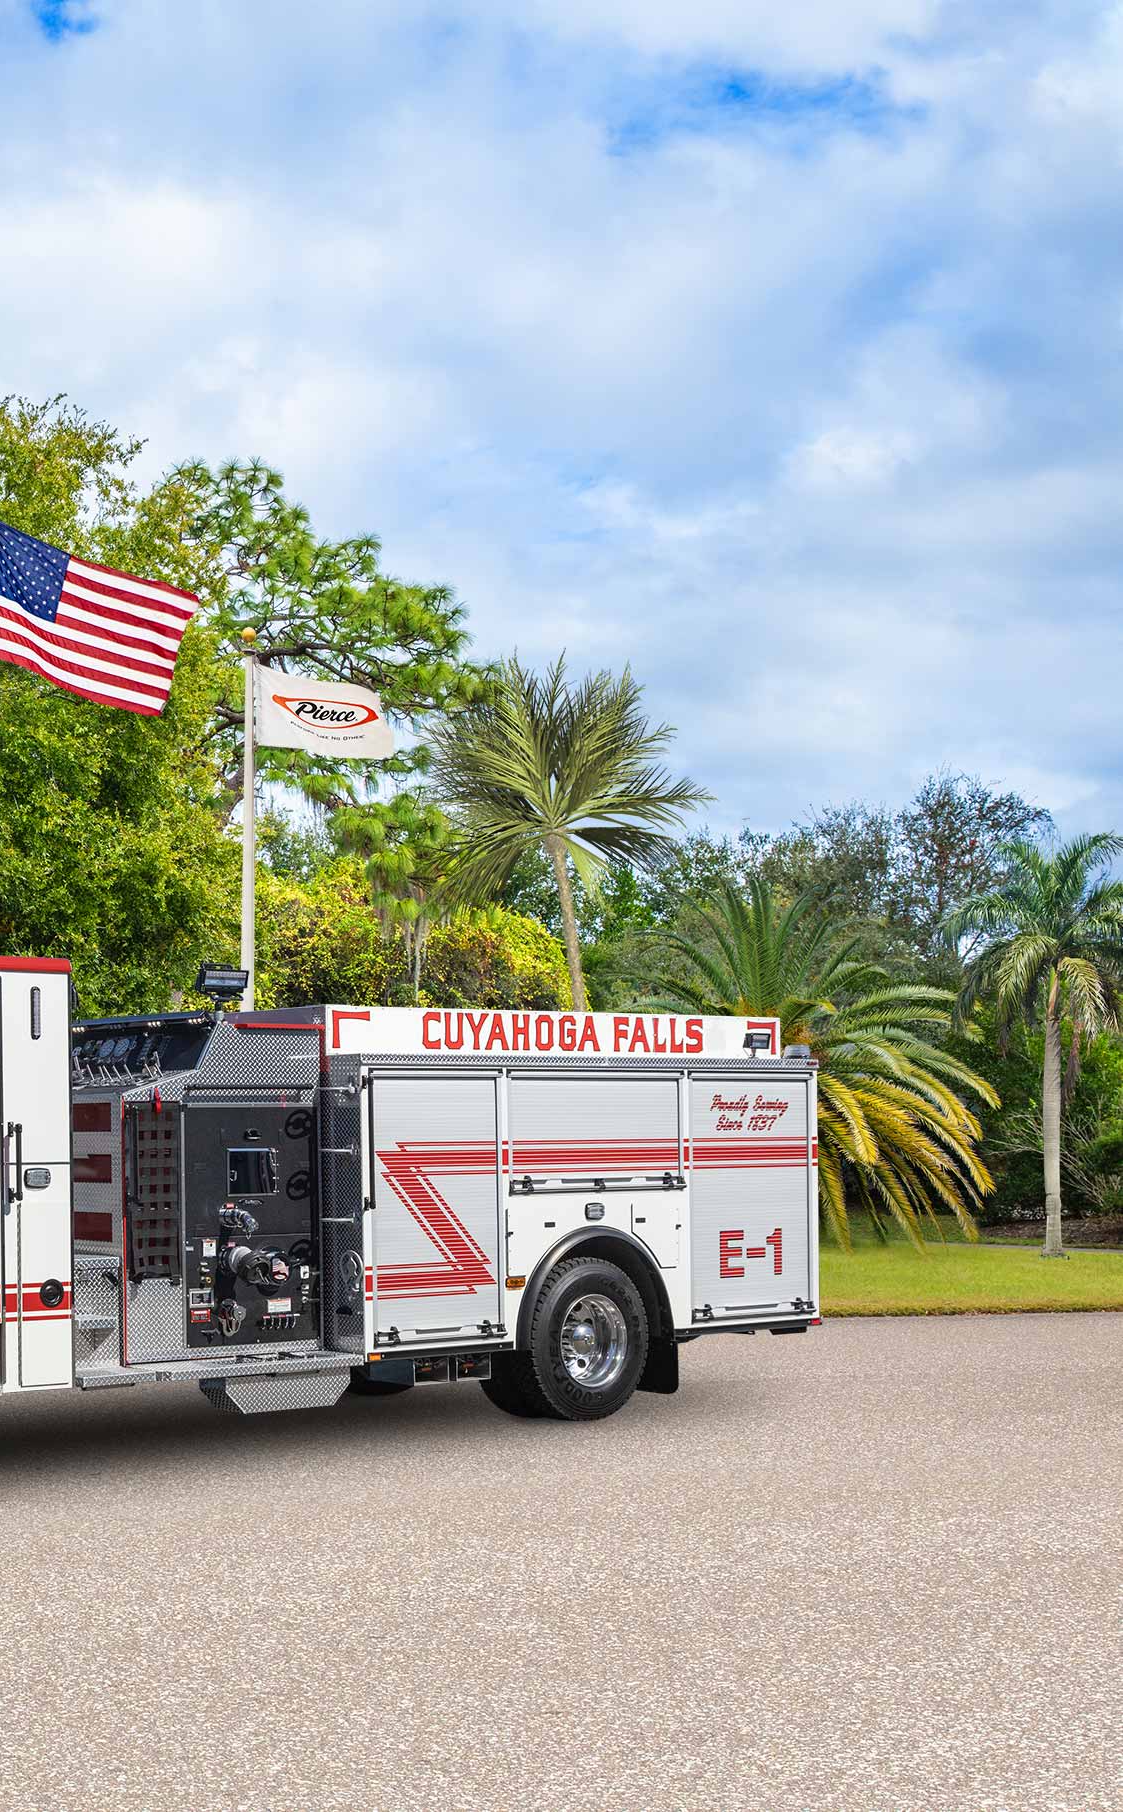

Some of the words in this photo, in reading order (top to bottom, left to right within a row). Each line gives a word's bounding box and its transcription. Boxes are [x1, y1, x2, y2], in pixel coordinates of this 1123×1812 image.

[295, 701, 356, 722] Pierce
[421, 1011, 601, 1051] CUYAHOGA
[613, 1016, 704, 1054] FALLS
[709, 1094, 749, 1117] Proudly
[752, 1094, 789, 1118] Serving
[716, 1114, 743, 1131] Since
[719, 1228, 783, 1278] E-1
